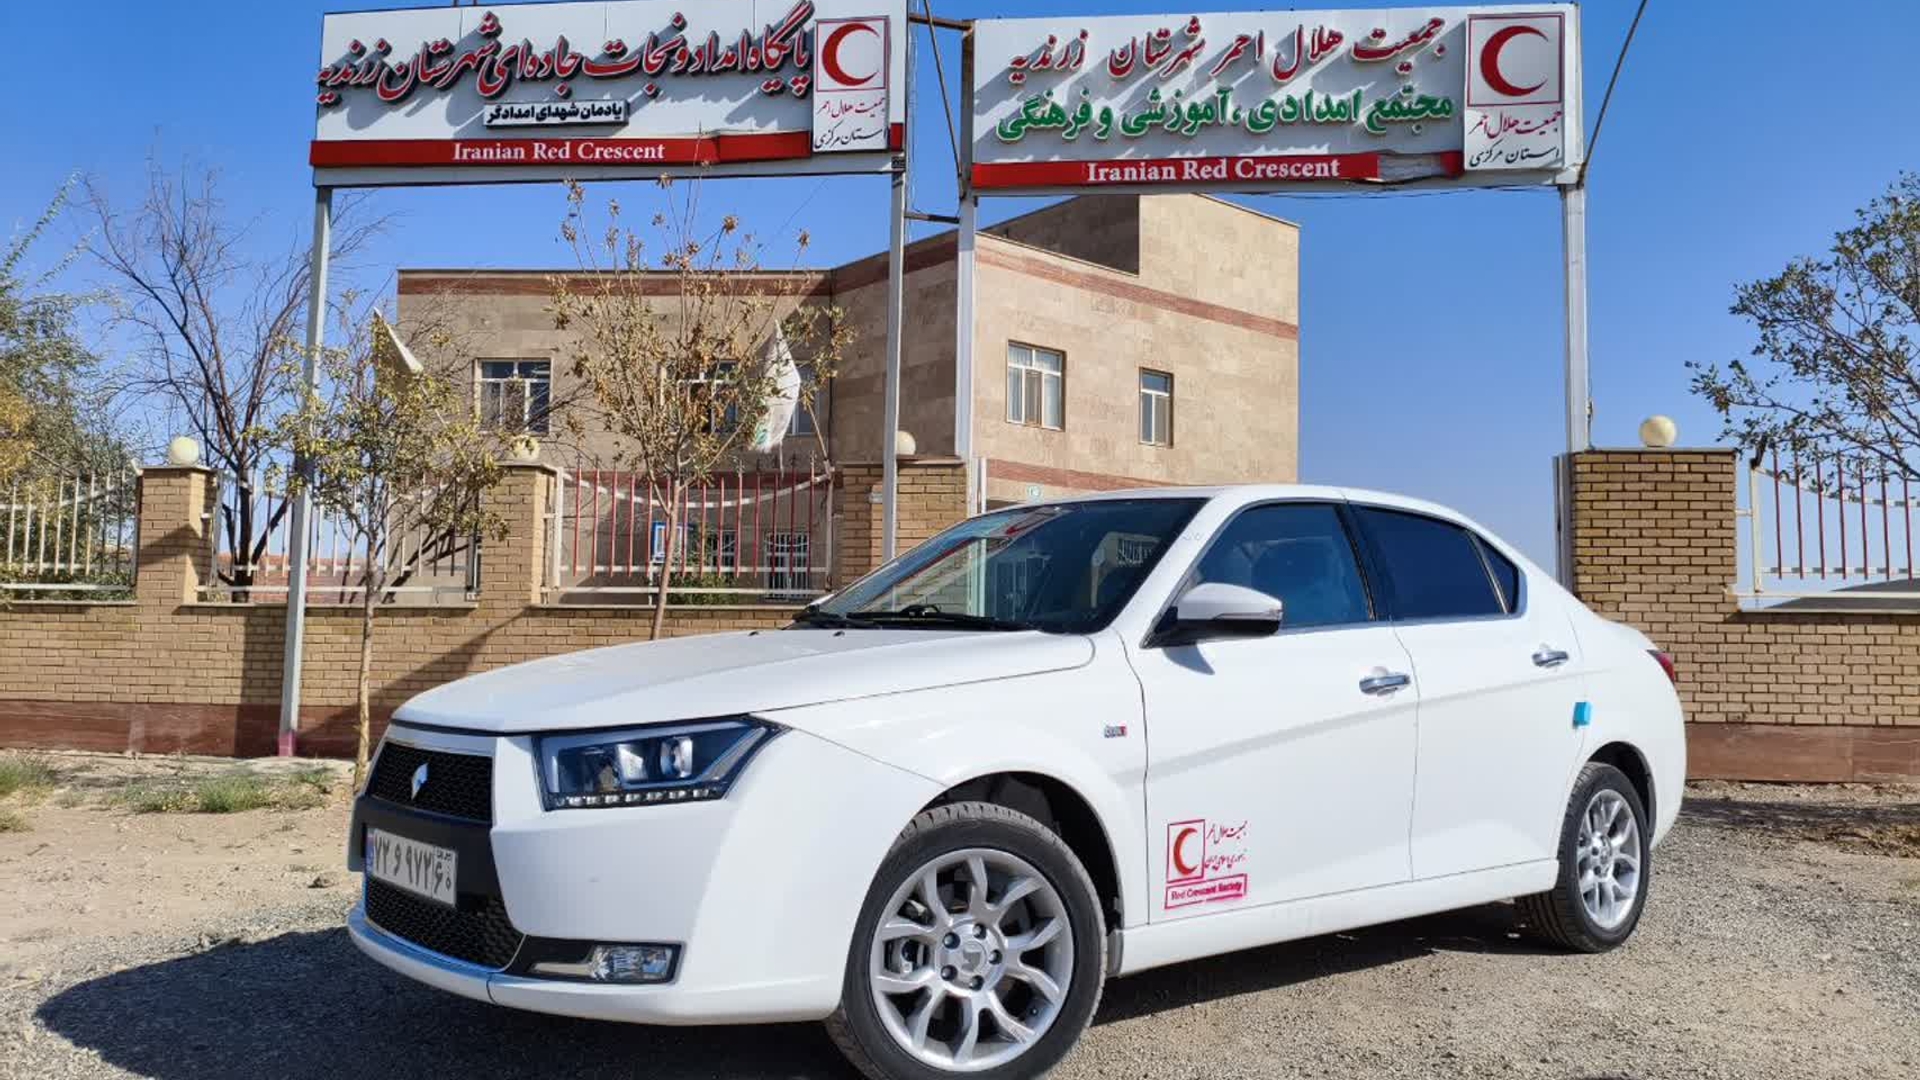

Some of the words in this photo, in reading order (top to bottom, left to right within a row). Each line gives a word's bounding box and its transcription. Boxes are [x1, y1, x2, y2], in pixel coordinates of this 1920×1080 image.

[376, 11, 501, 101] شهرستان
[582, 12, 684, 96] نجات
[671, 37, 686, 73] و
[688, 29, 748, 72] امداد
[747, 1, 812, 97] پایگاه
[1009, 29, 1089, 82] زرندیه
[1107, 16, 1206, 78] شهرستان
[1210, 29, 1265, 77] احمر
[1272, 24, 1344, 82] هلال
[1352, 17, 1447, 75] جمعیت
[316, 38, 391, 104] زرندیه
[487, 104, 535, 123] امدادگر
[536, 102, 580, 121] شهدای
[580, 101, 622, 119] یادمان
[831, 99, 854, 118] هلال
[855, 97, 886, 118] جمعیت
[996, 86, 1093, 141] فرهنگی
[1094, 105, 1114, 139] و
[1120, 86, 1233, 137] آموزشی
[1366, 85, 1455, 133] مجتمع
[1515, 111, 1562, 135] جمعیت
[814, 119, 845, 149] مرکزی
[840, 126, 887, 145] استان
[1487, 112, 1520, 139] هلال
[452, 142, 525, 161] Iranian
[533, 141, 571, 160] Red
[577, 141, 665, 160] Crescent
[1469, 138, 1504, 167] مرکزی
[1505, 146, 1559, 164] استان
[1087, 161, 1177, 182] Iranian
[1182, 159, 1228, 180] Red
[1235, 158, 1341, 179] Crescent
